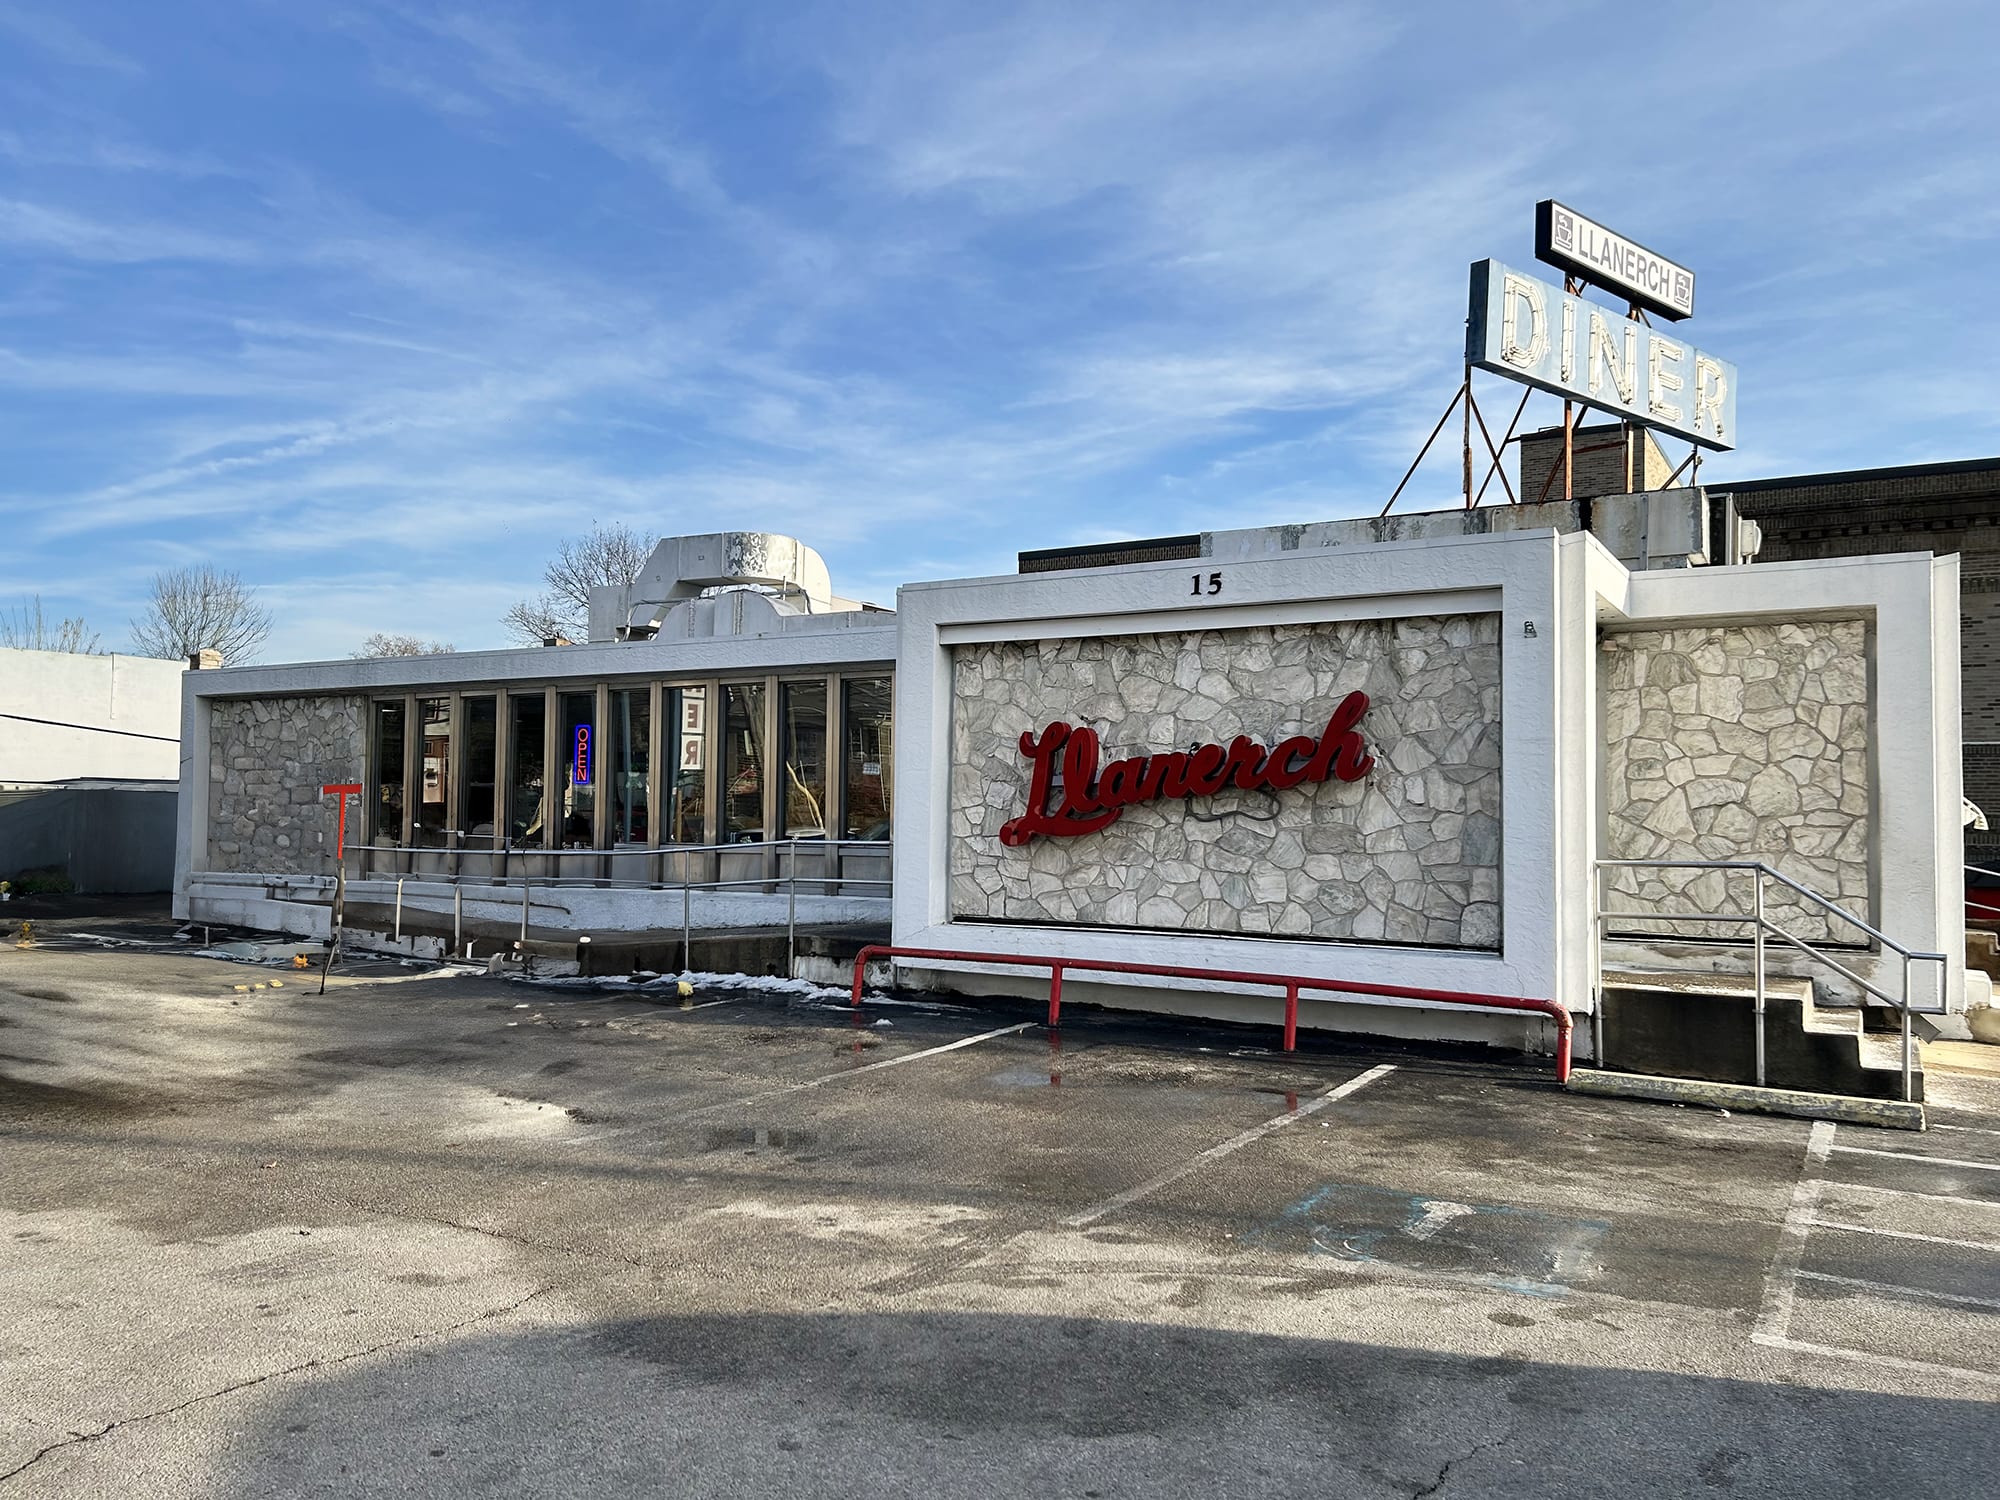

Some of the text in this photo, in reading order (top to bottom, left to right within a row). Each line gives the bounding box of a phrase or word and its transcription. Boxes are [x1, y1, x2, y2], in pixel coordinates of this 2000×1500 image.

[1578, 224, 1670, 298] LLANERCH
[1501, 272, 1728, 438] DINER
[1190, 571, 1222, 596] 15
[577, 728, 589, 781] OPEN
[1000, 690, 1375, 847] Llanerch
